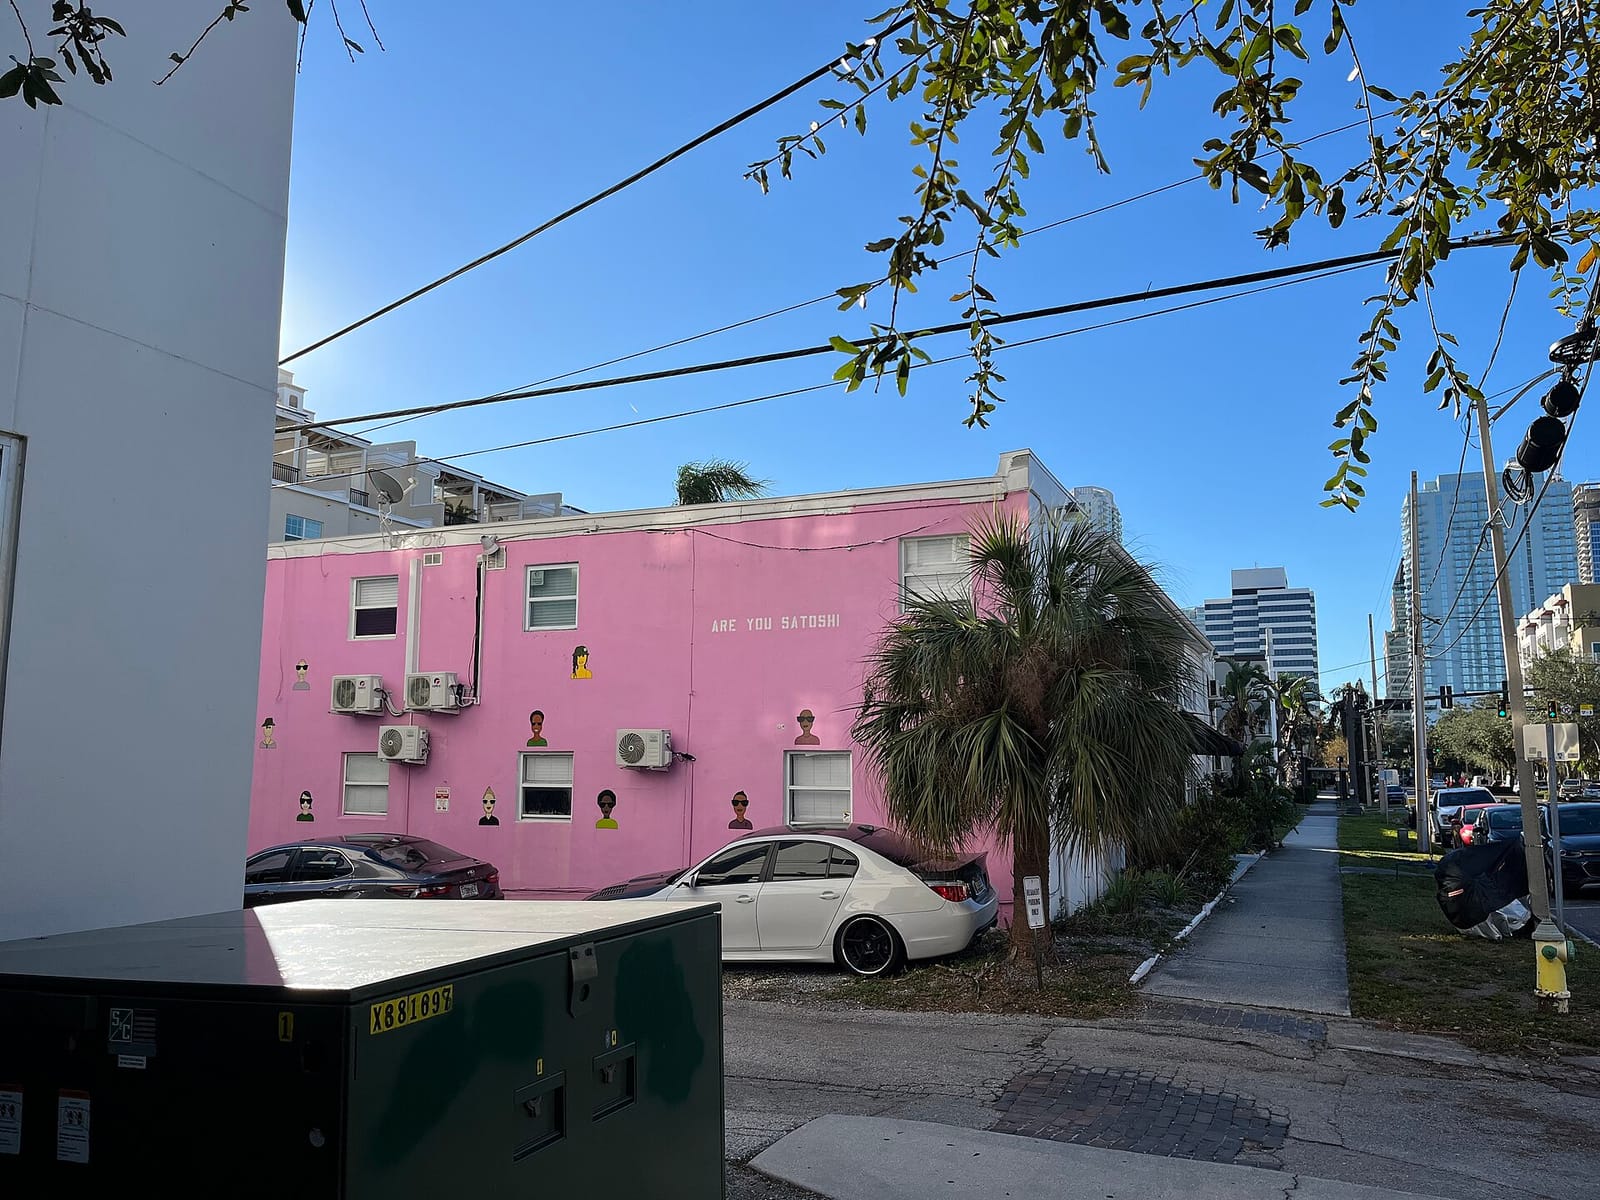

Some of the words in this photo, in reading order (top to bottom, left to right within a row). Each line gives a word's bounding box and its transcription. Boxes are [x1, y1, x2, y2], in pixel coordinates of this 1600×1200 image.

[711, 618, 737, 633] ARE
[747, 617, 772, 631] YOU
[781, 614, 840, 630] SATOSHI
